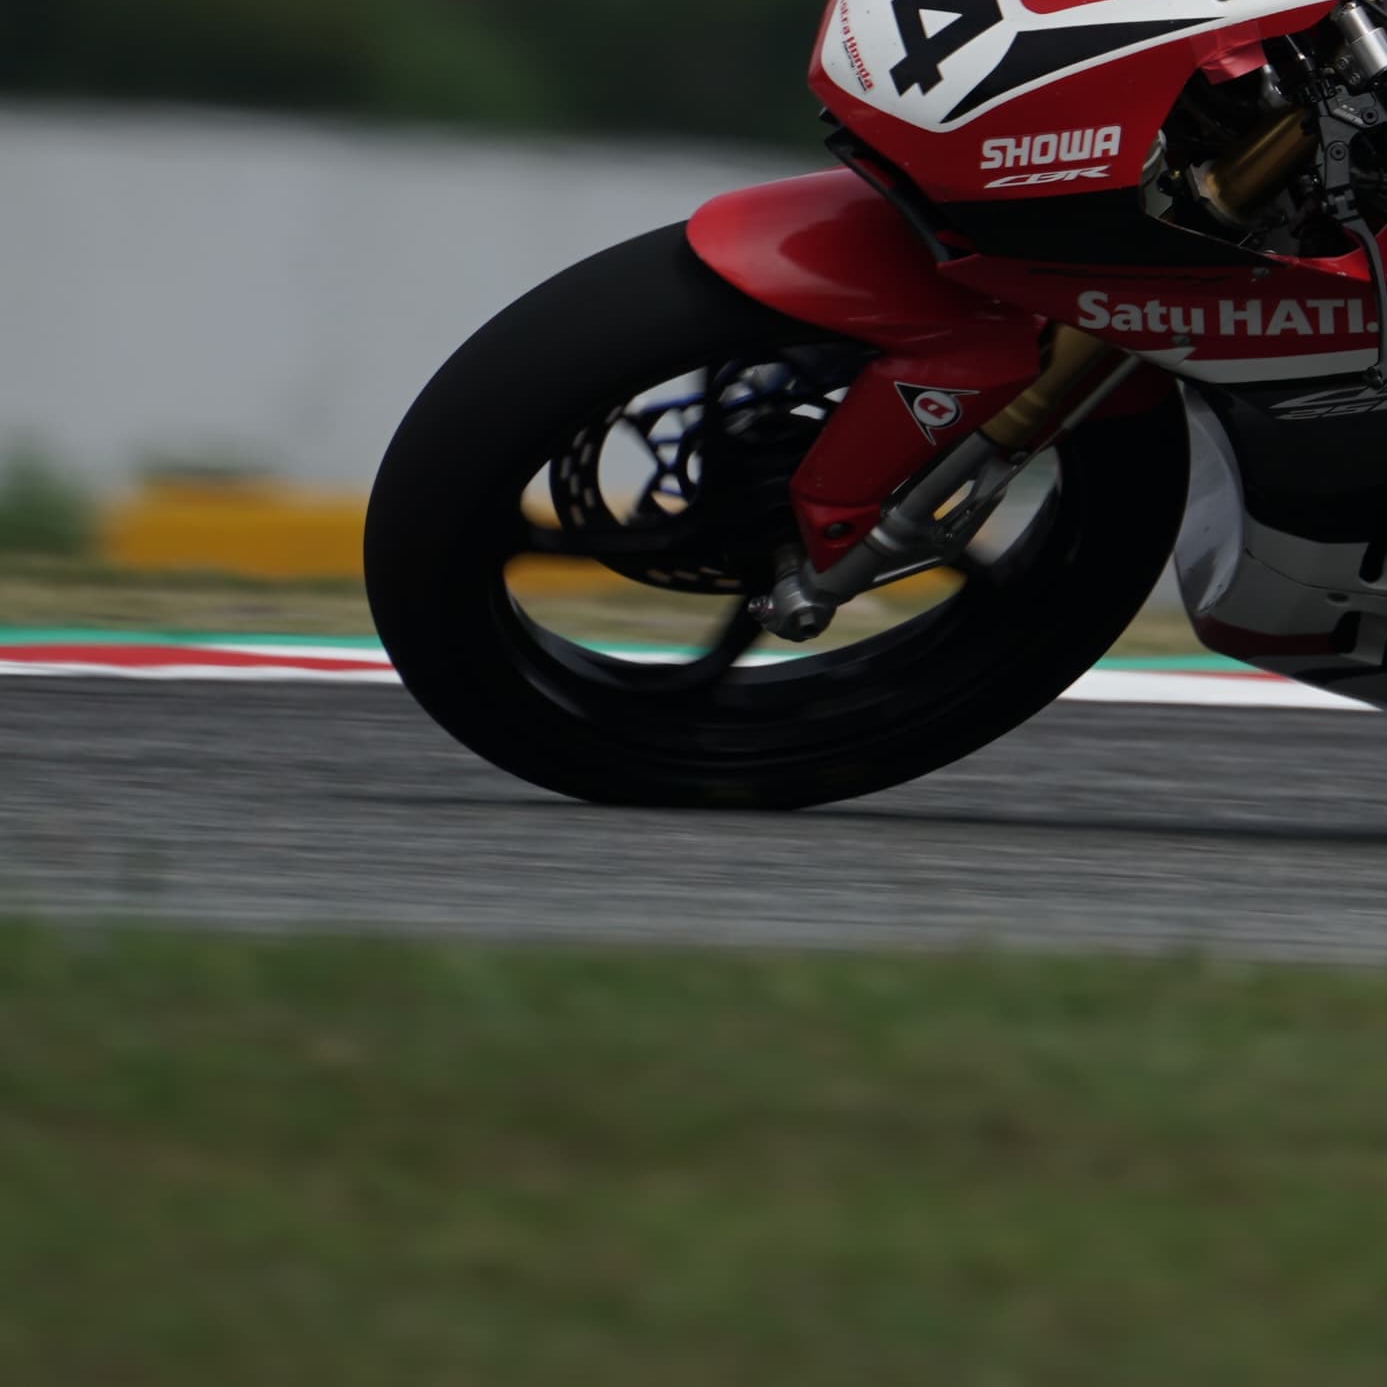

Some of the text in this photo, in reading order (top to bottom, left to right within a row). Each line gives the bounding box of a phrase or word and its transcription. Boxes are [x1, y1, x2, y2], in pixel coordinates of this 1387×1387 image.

[847, 37, 875, 89] Honda
[980, 125, 1121, 170] SHOWA
[983, 164, 1111, 190] CBR
[1077, 290, 1380, 337] Satu HATI.
